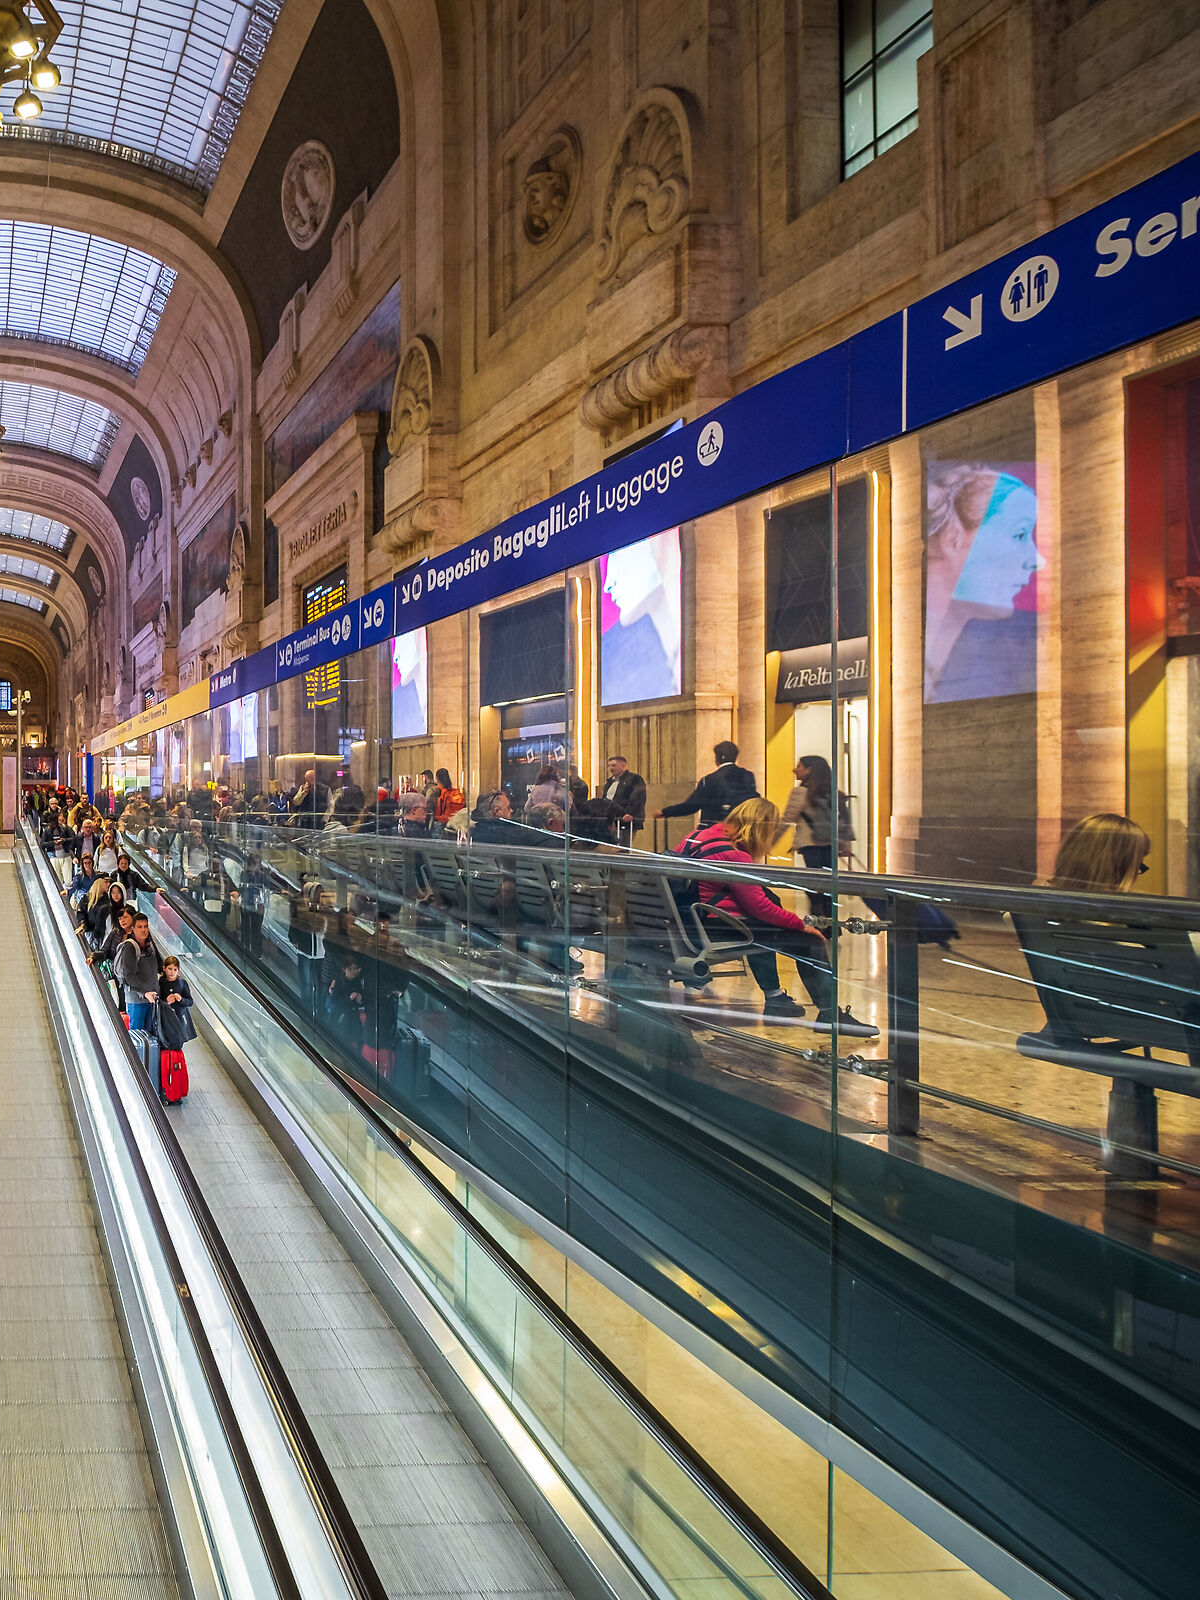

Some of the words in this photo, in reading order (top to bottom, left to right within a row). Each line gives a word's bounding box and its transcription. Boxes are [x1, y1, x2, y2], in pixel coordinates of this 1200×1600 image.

[427, 547, 490, 592] Deposito
[596, 455, 684, 514] Luggage
[293, 628, 319, 654] Terminal
[319, 626, 331, 643] Bus
